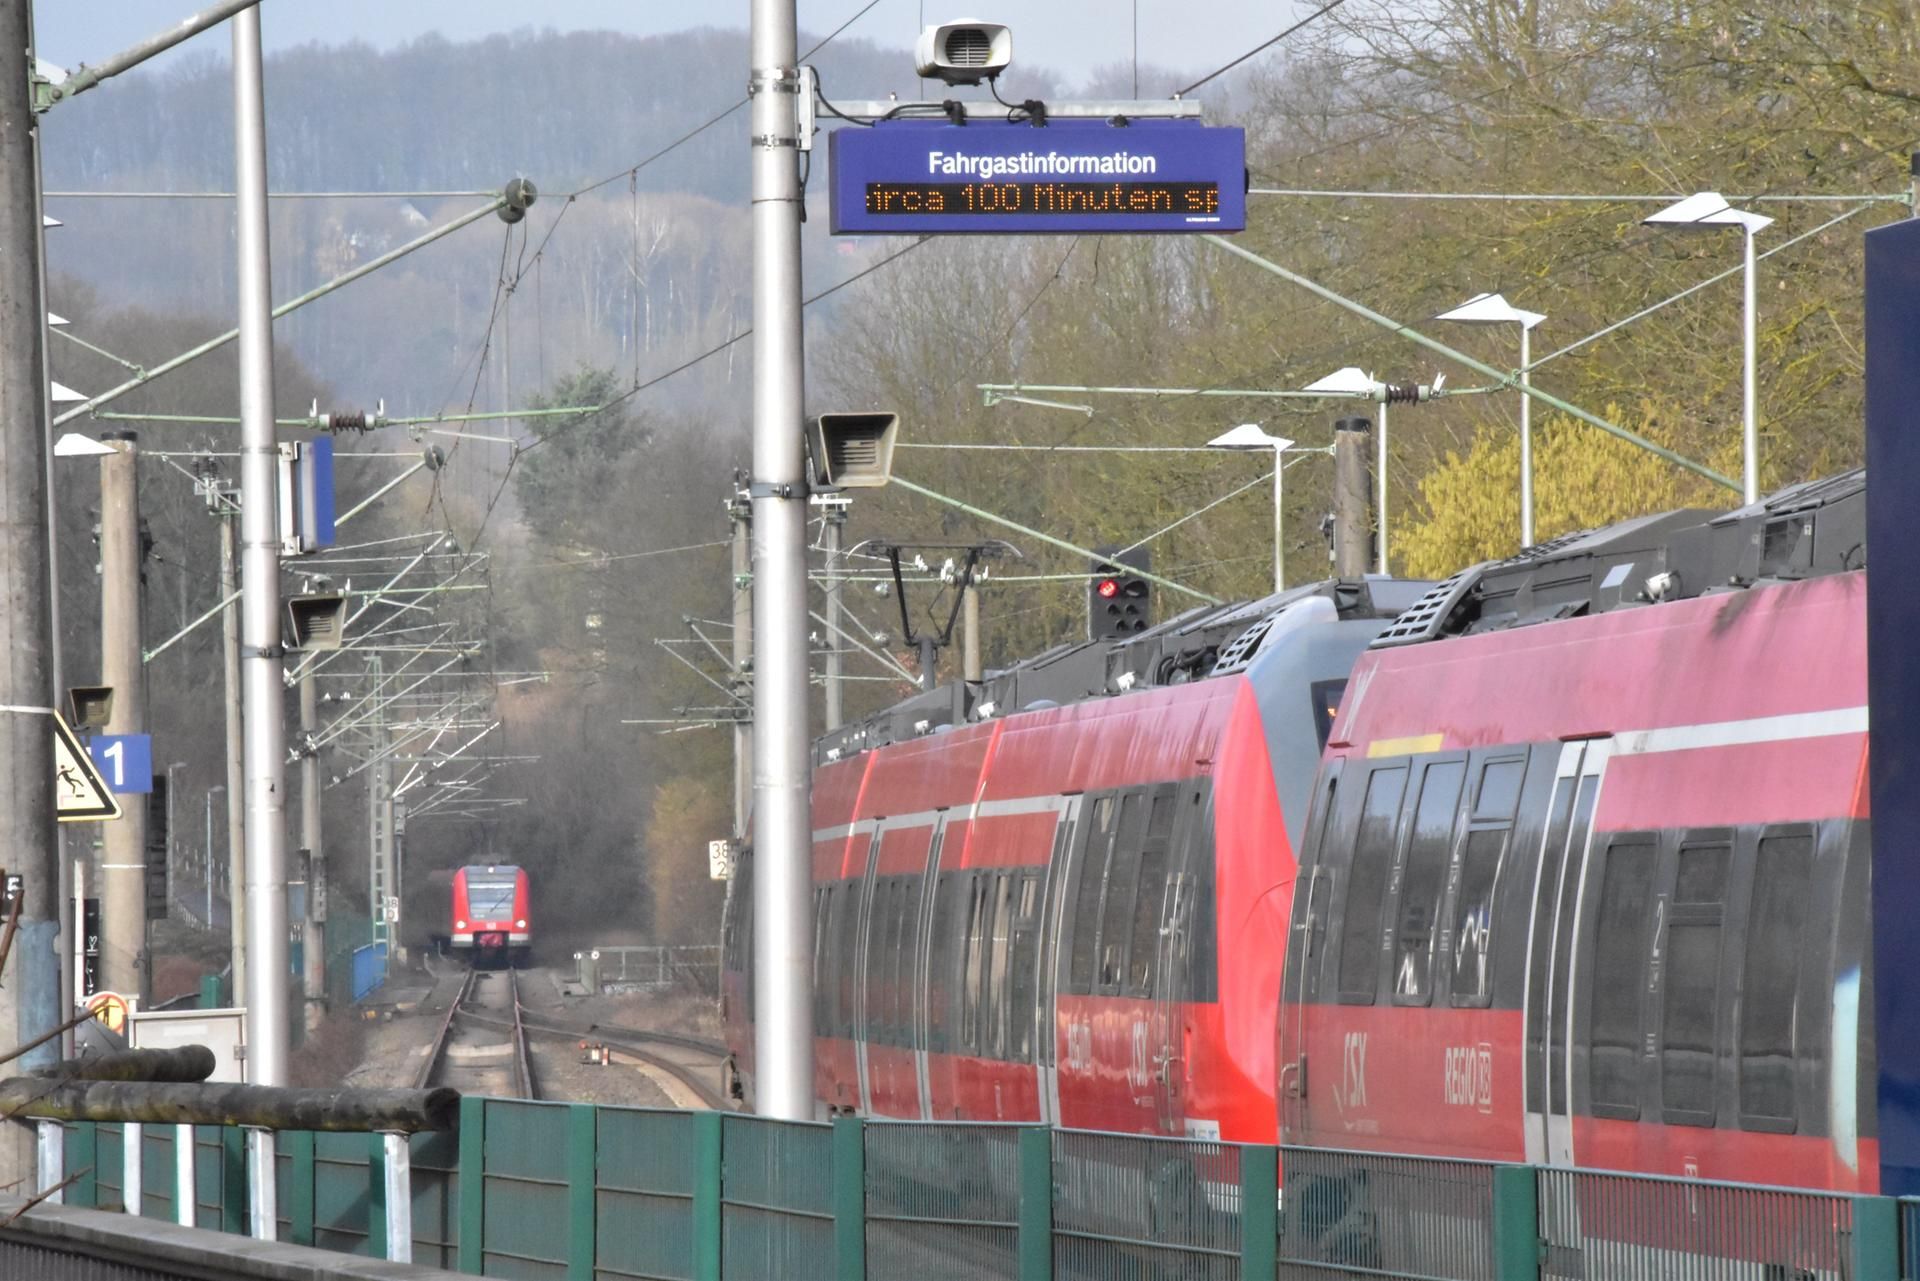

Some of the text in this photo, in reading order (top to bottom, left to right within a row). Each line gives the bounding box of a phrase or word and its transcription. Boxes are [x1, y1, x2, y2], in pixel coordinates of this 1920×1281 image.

[928, 152, 1156, 179] Fahrgastinformation
[962, 184, 1021, 210] 100
[1034, 184, 1173, 210] Minuten
[103, 741, 124, 786] 1
[1445, 1047, 1476, 1106] REGIO
